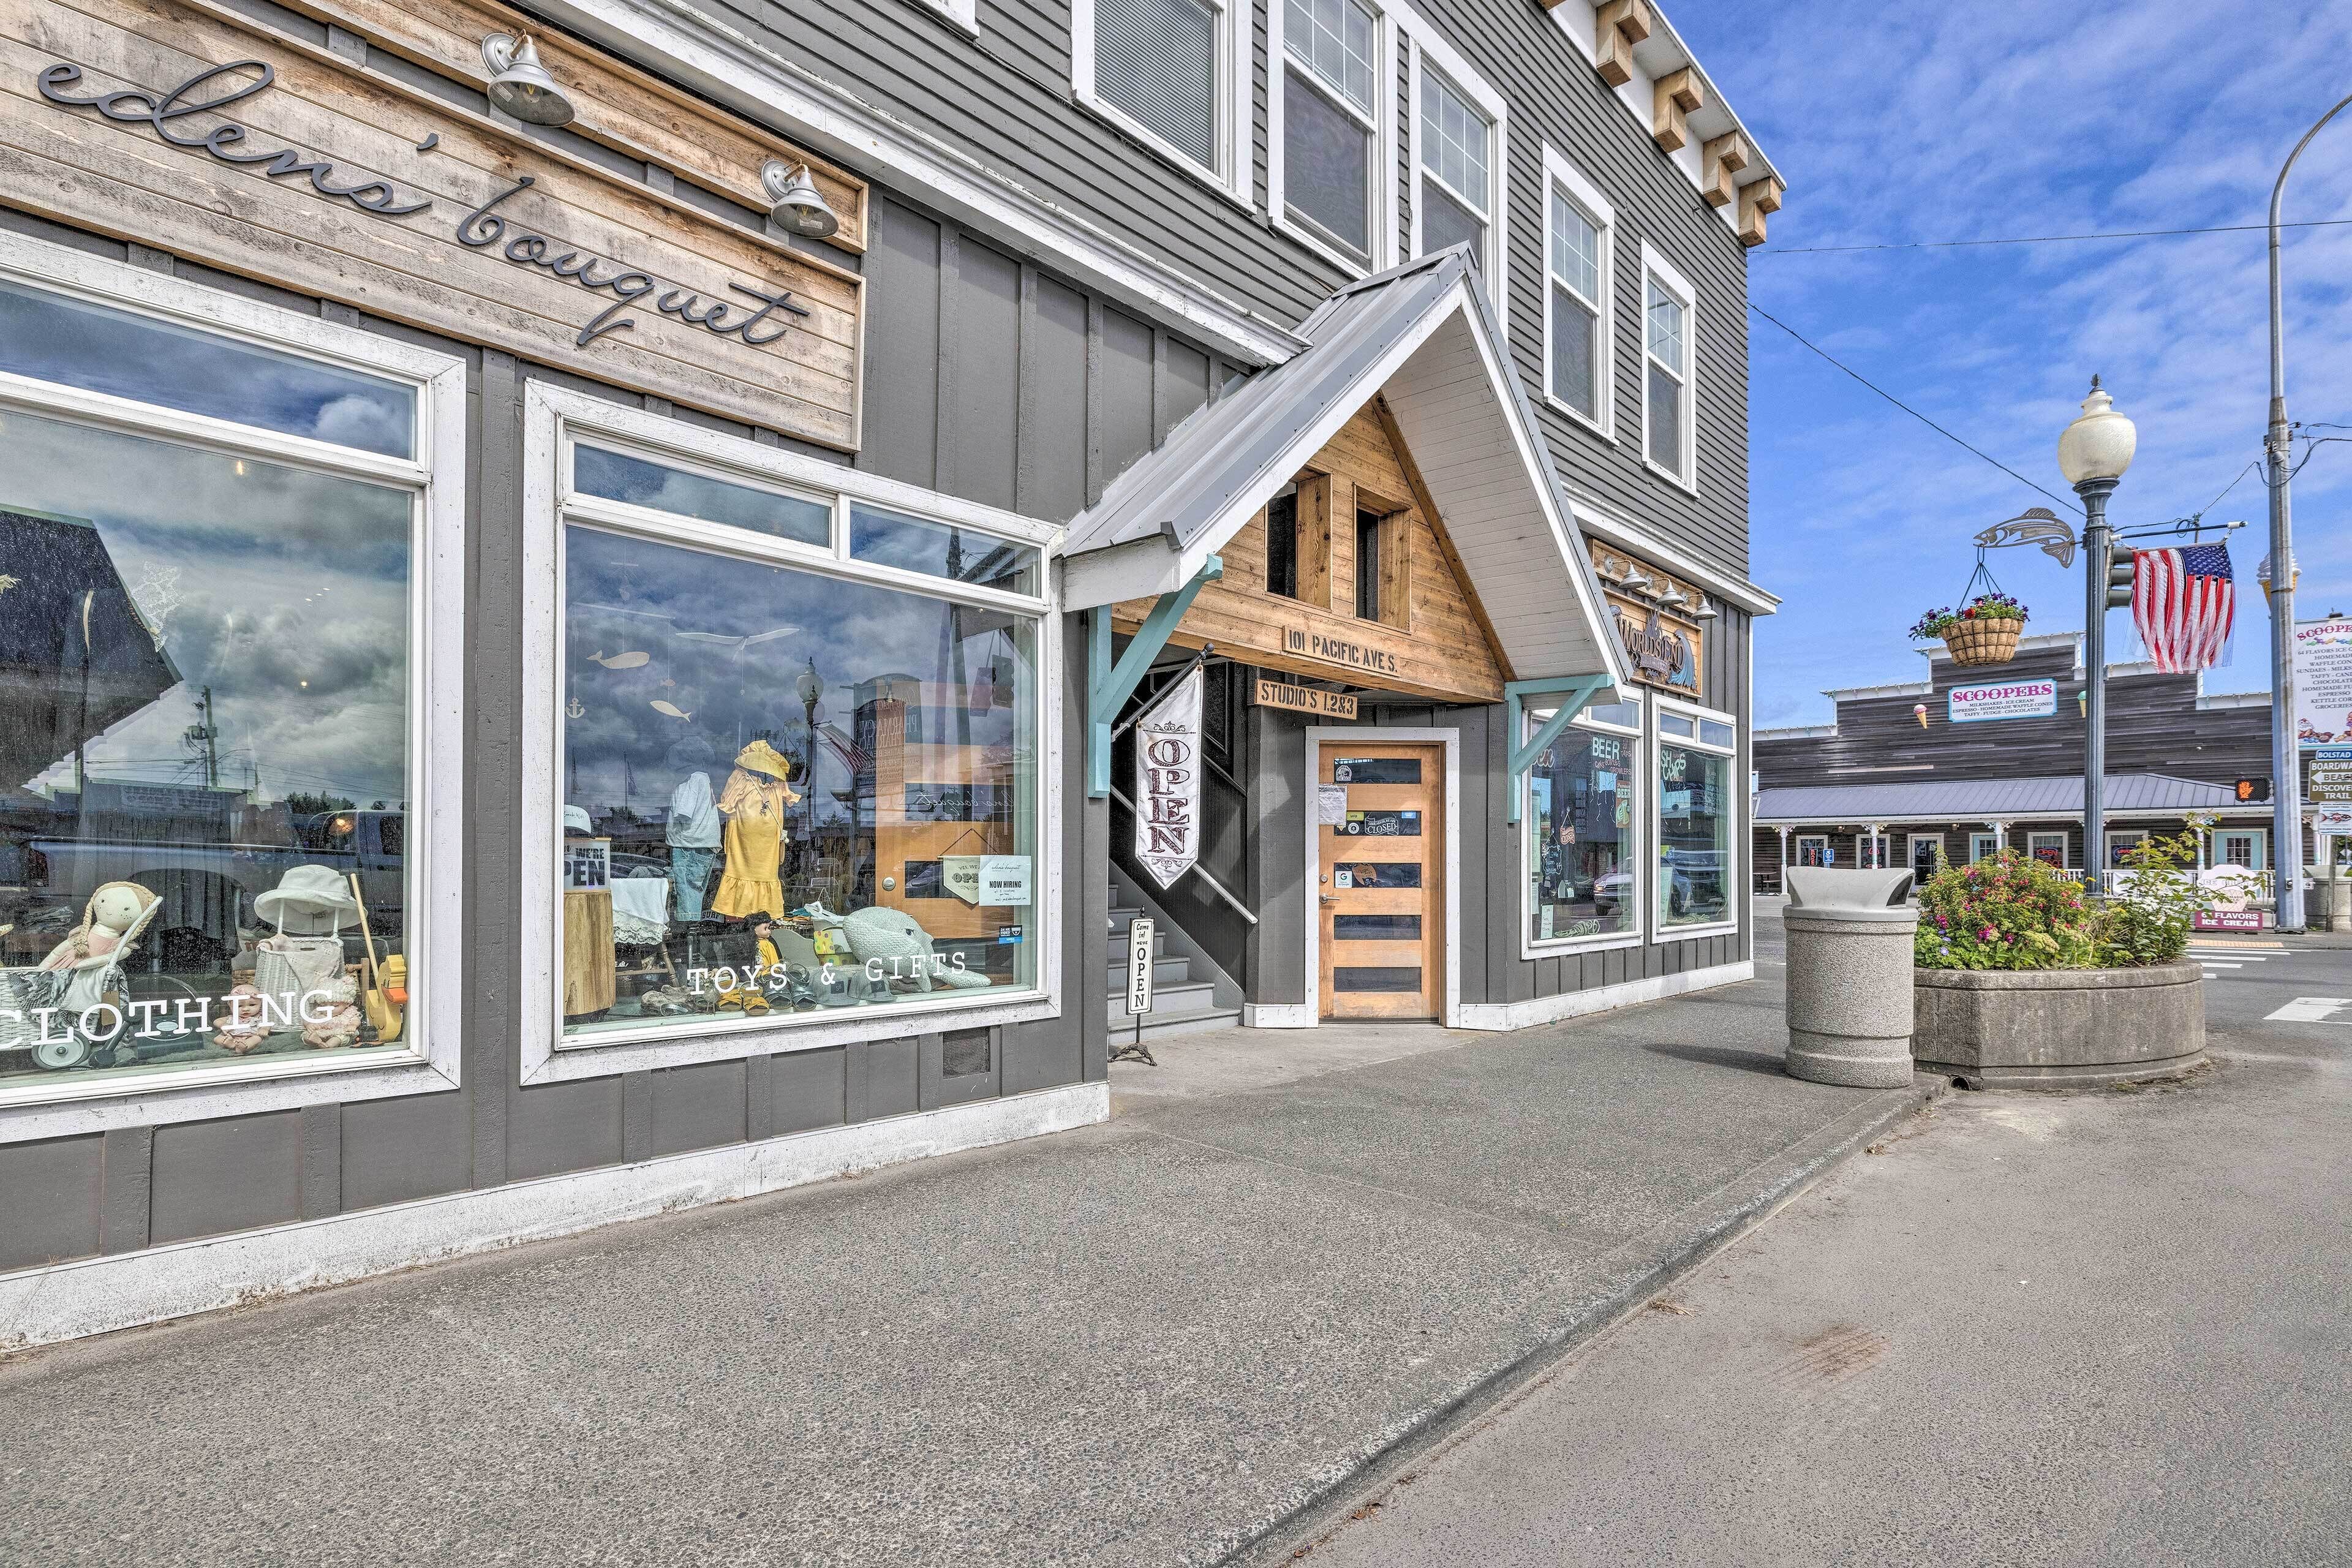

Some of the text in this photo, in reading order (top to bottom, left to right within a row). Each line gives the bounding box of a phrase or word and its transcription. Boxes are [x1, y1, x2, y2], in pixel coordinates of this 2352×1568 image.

[457, 176, 810, 346] bouquet
[1289, 630, 1397, 673] 101 PACIFIC AVE S.
[1261, 682, 1317, 709] STUDIO'S
[1953, 684, 2052, 703] SCOOPERS
[1593, 737, 1620, 760] BEER
[2311, 762, 2352, 771] BOARDWA
[1148, 739, 1190, 855] OPEN
[1617, 788, 1630, 798] BEER
[1368, 823, 1396, 834] CLOSED
[576, 848, 605, 859] WE'RE
[564, 861, 605, 886] PEN
[951, 873, 979, 883] OPE
[702, 911, 720, 919] SURF
[687, 951, 966, 995] TOYS & GIFTS
[1135, 948, 1146, 1008] OPEN
